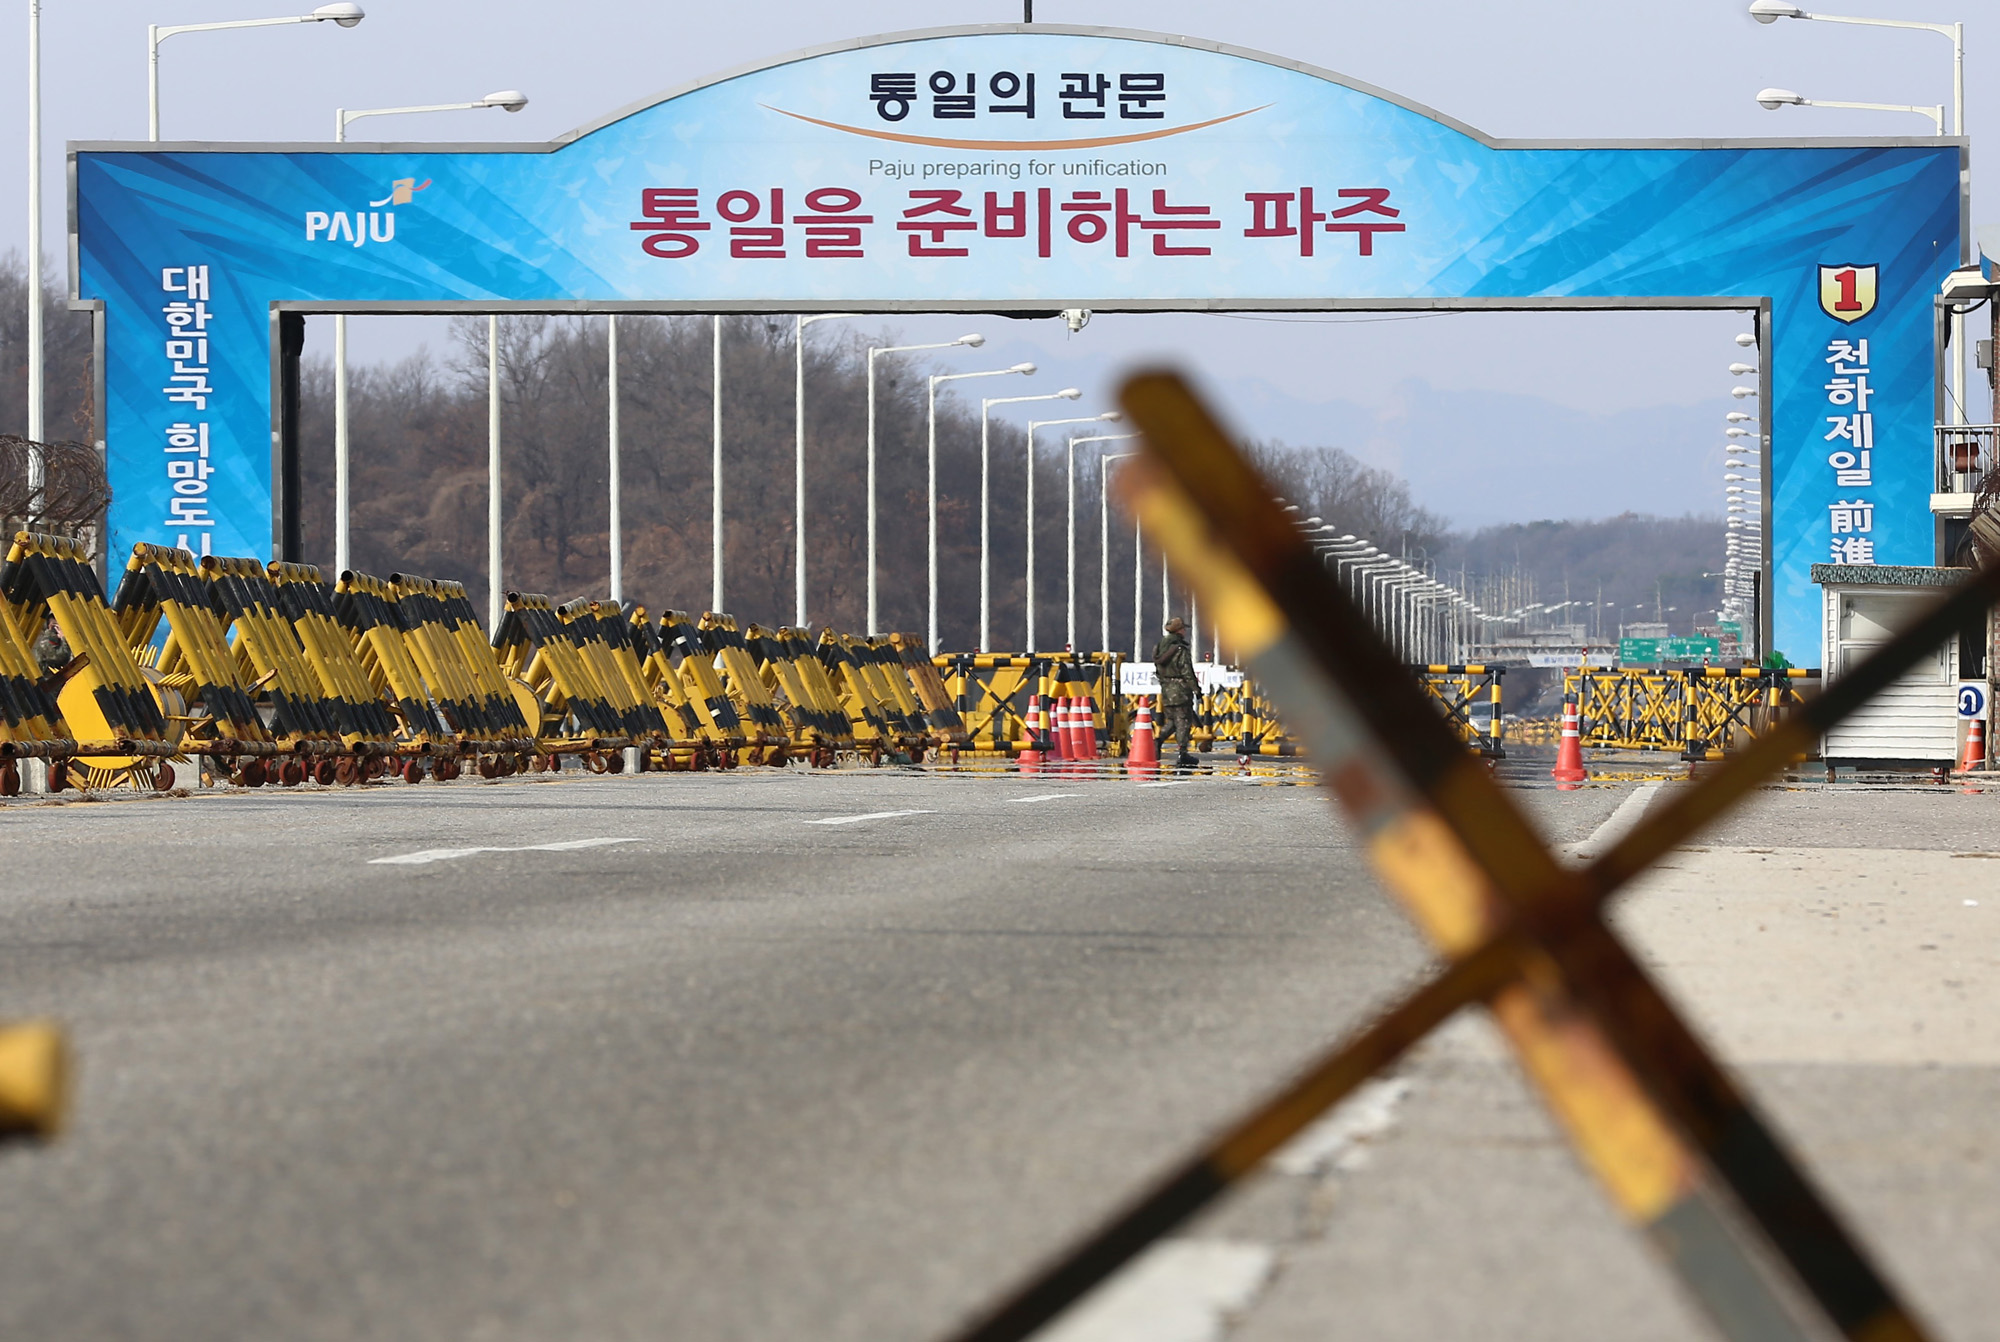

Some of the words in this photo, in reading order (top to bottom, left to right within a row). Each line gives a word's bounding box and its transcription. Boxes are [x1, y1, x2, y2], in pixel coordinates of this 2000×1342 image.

[869, 71, 1034, 119] 통일의
[1059, 72, 1166, 117] 관문
[869, 159, 915, 180] Paju
[922, 159, 1021, 180] preparing
[1028, 159, 1057, 176] for
[1062, 159, 1167, 176] unification
[305, 211, 395, 247] PAJU
[630, 187, 874, 259] 통일을
[896, 187, 1221, 258] 준비하는
[1244, 186, 1406, 257] 파주
[1834, 269, 1862, 311] 1
[162, 265, 213, 410] 대한민국
[1824, 339, 1875, 487] 천하제일
